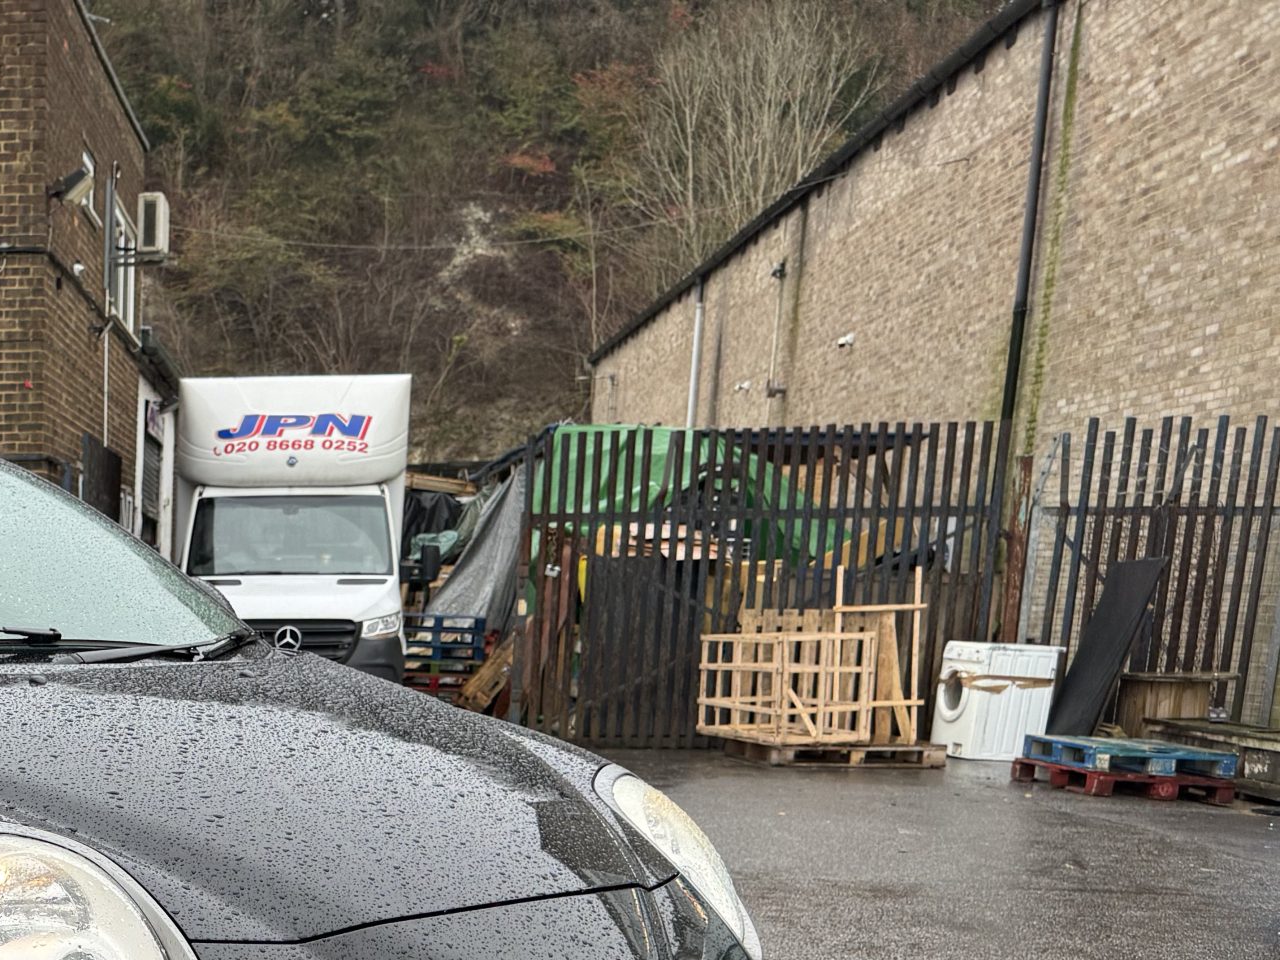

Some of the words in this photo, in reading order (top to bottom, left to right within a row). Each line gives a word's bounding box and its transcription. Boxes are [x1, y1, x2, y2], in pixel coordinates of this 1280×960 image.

[217, 413, 373, 441] JPN
[223, 440, 260, 455] 020
[266, 439, 315, 451] 8668
[321, 439, 369, 454] 0252
